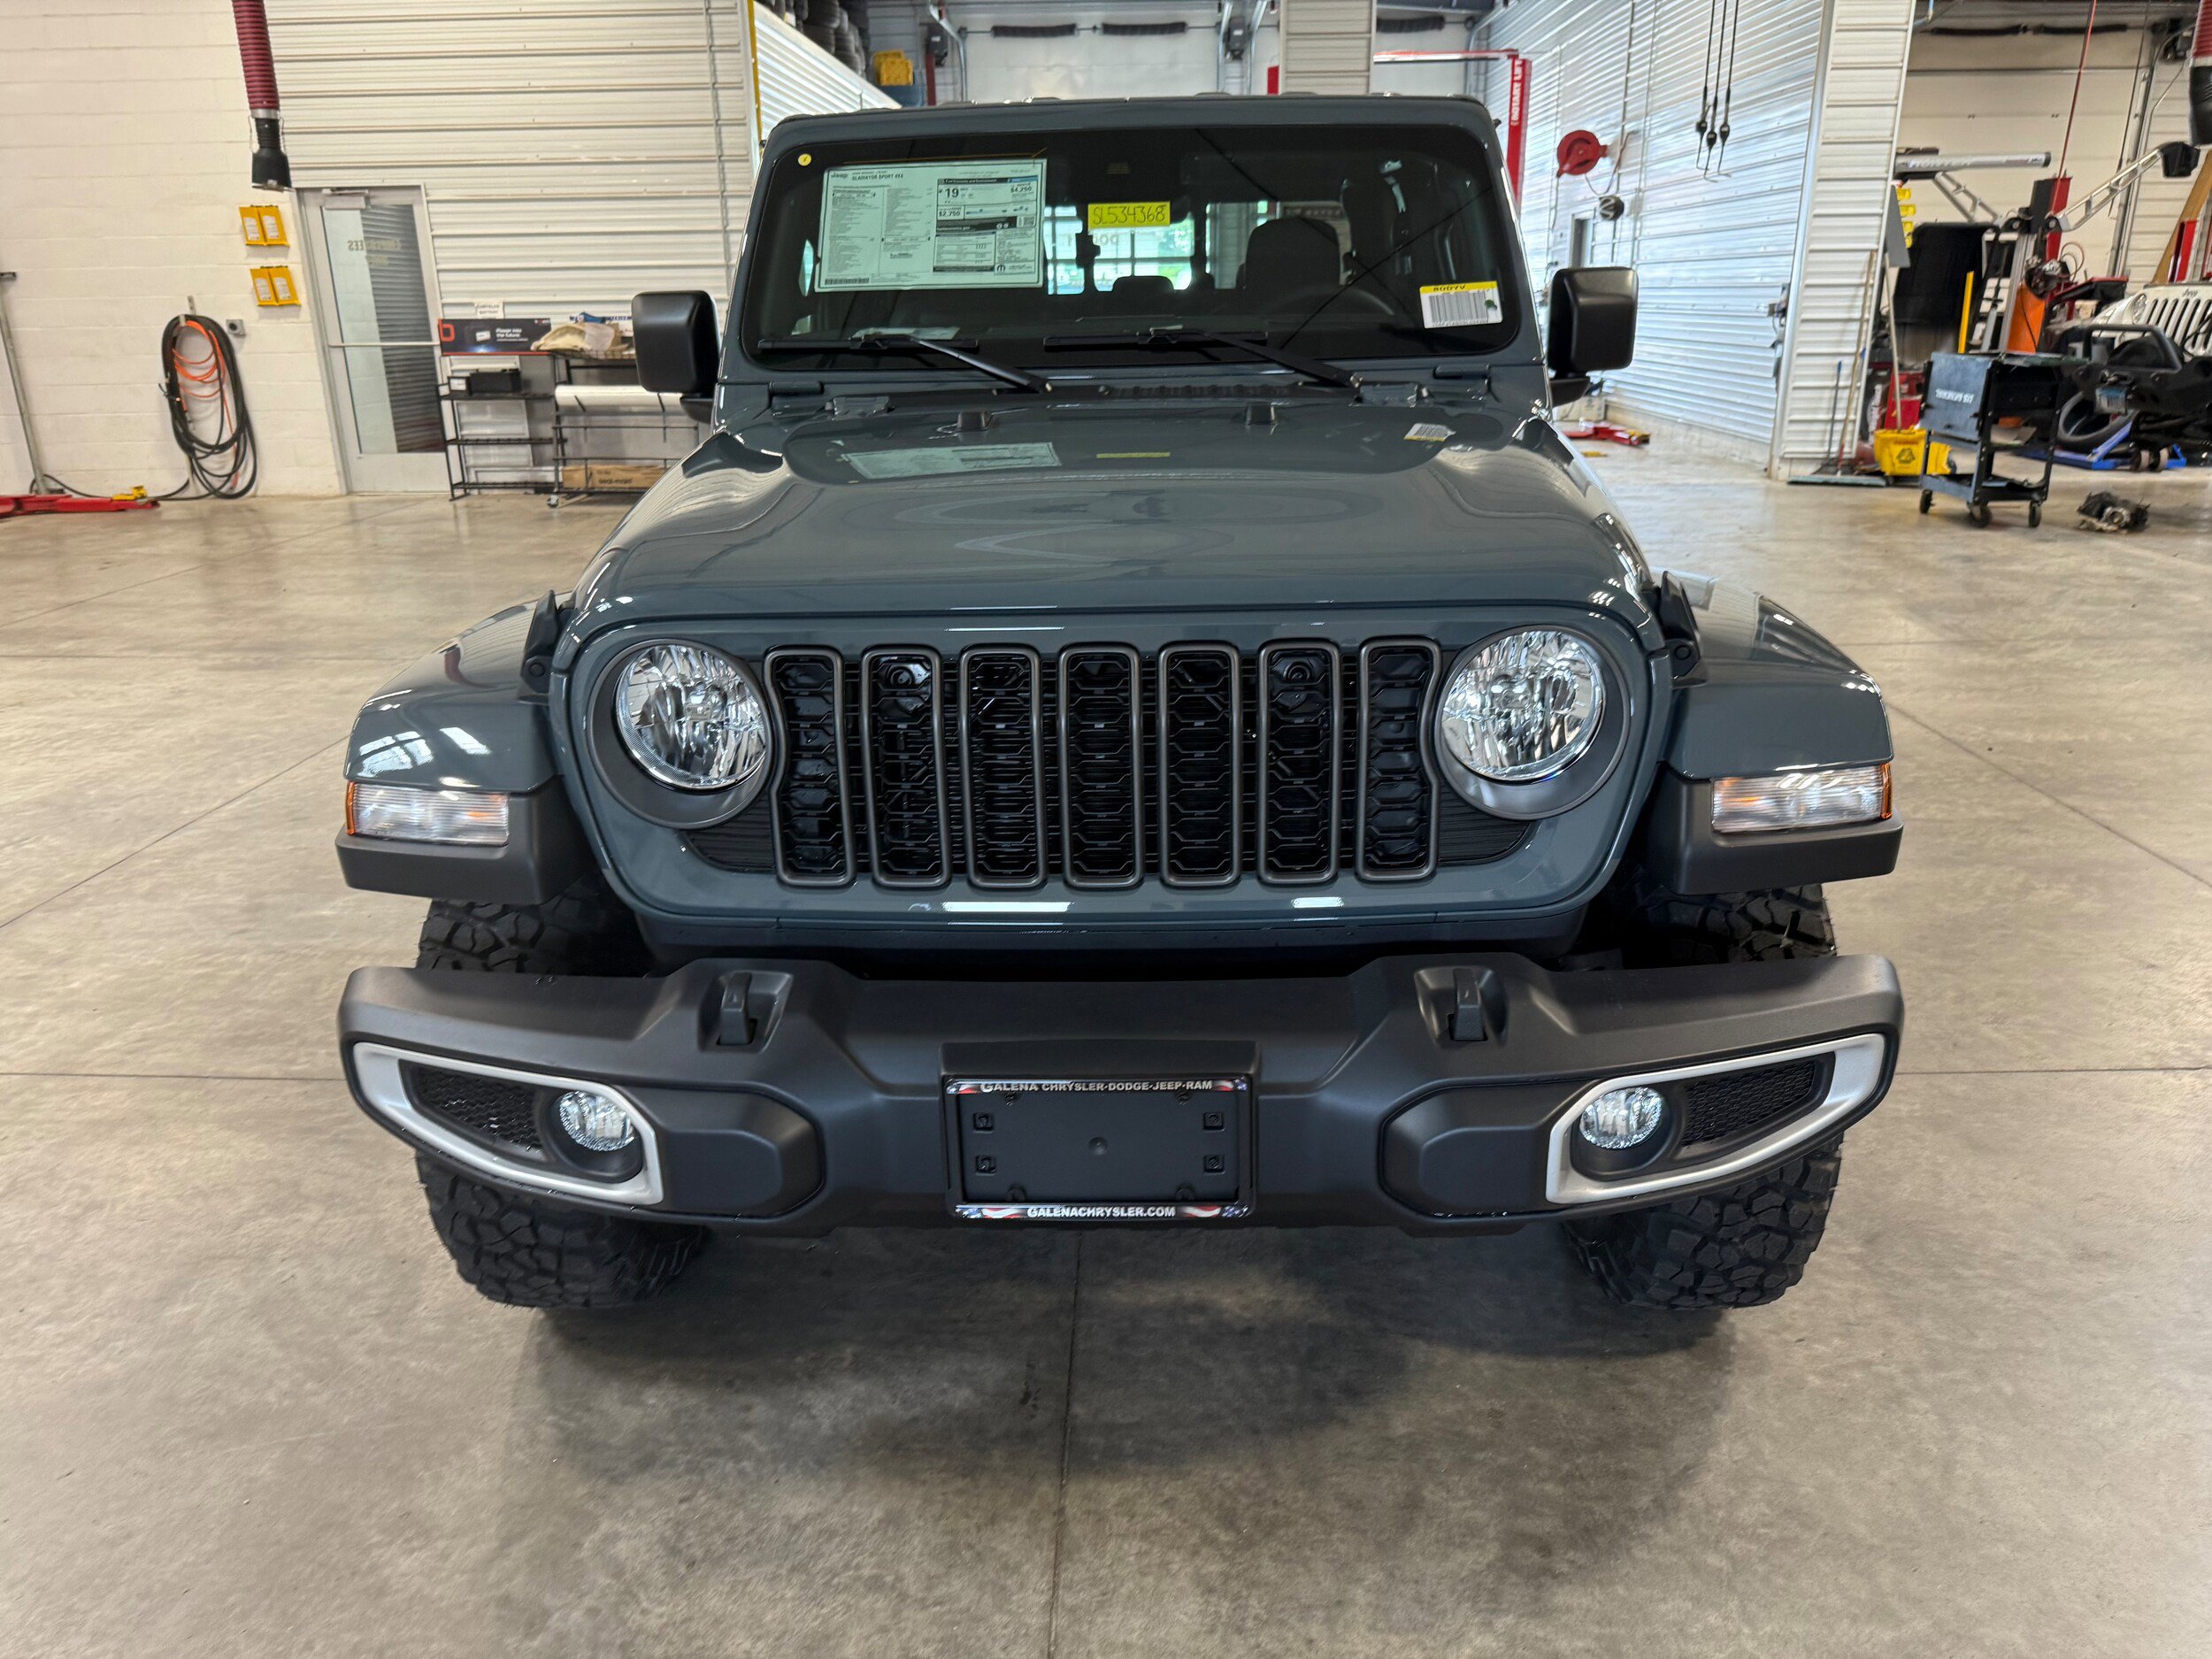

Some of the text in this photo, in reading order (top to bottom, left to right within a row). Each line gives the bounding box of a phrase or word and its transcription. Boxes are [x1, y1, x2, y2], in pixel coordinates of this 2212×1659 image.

[945, 188, 959, 198] 19
[979, 1081, 1039, 1093] GALENA
[1026, 1205, 1176, 1218] GALENACHRYSLER.COM
